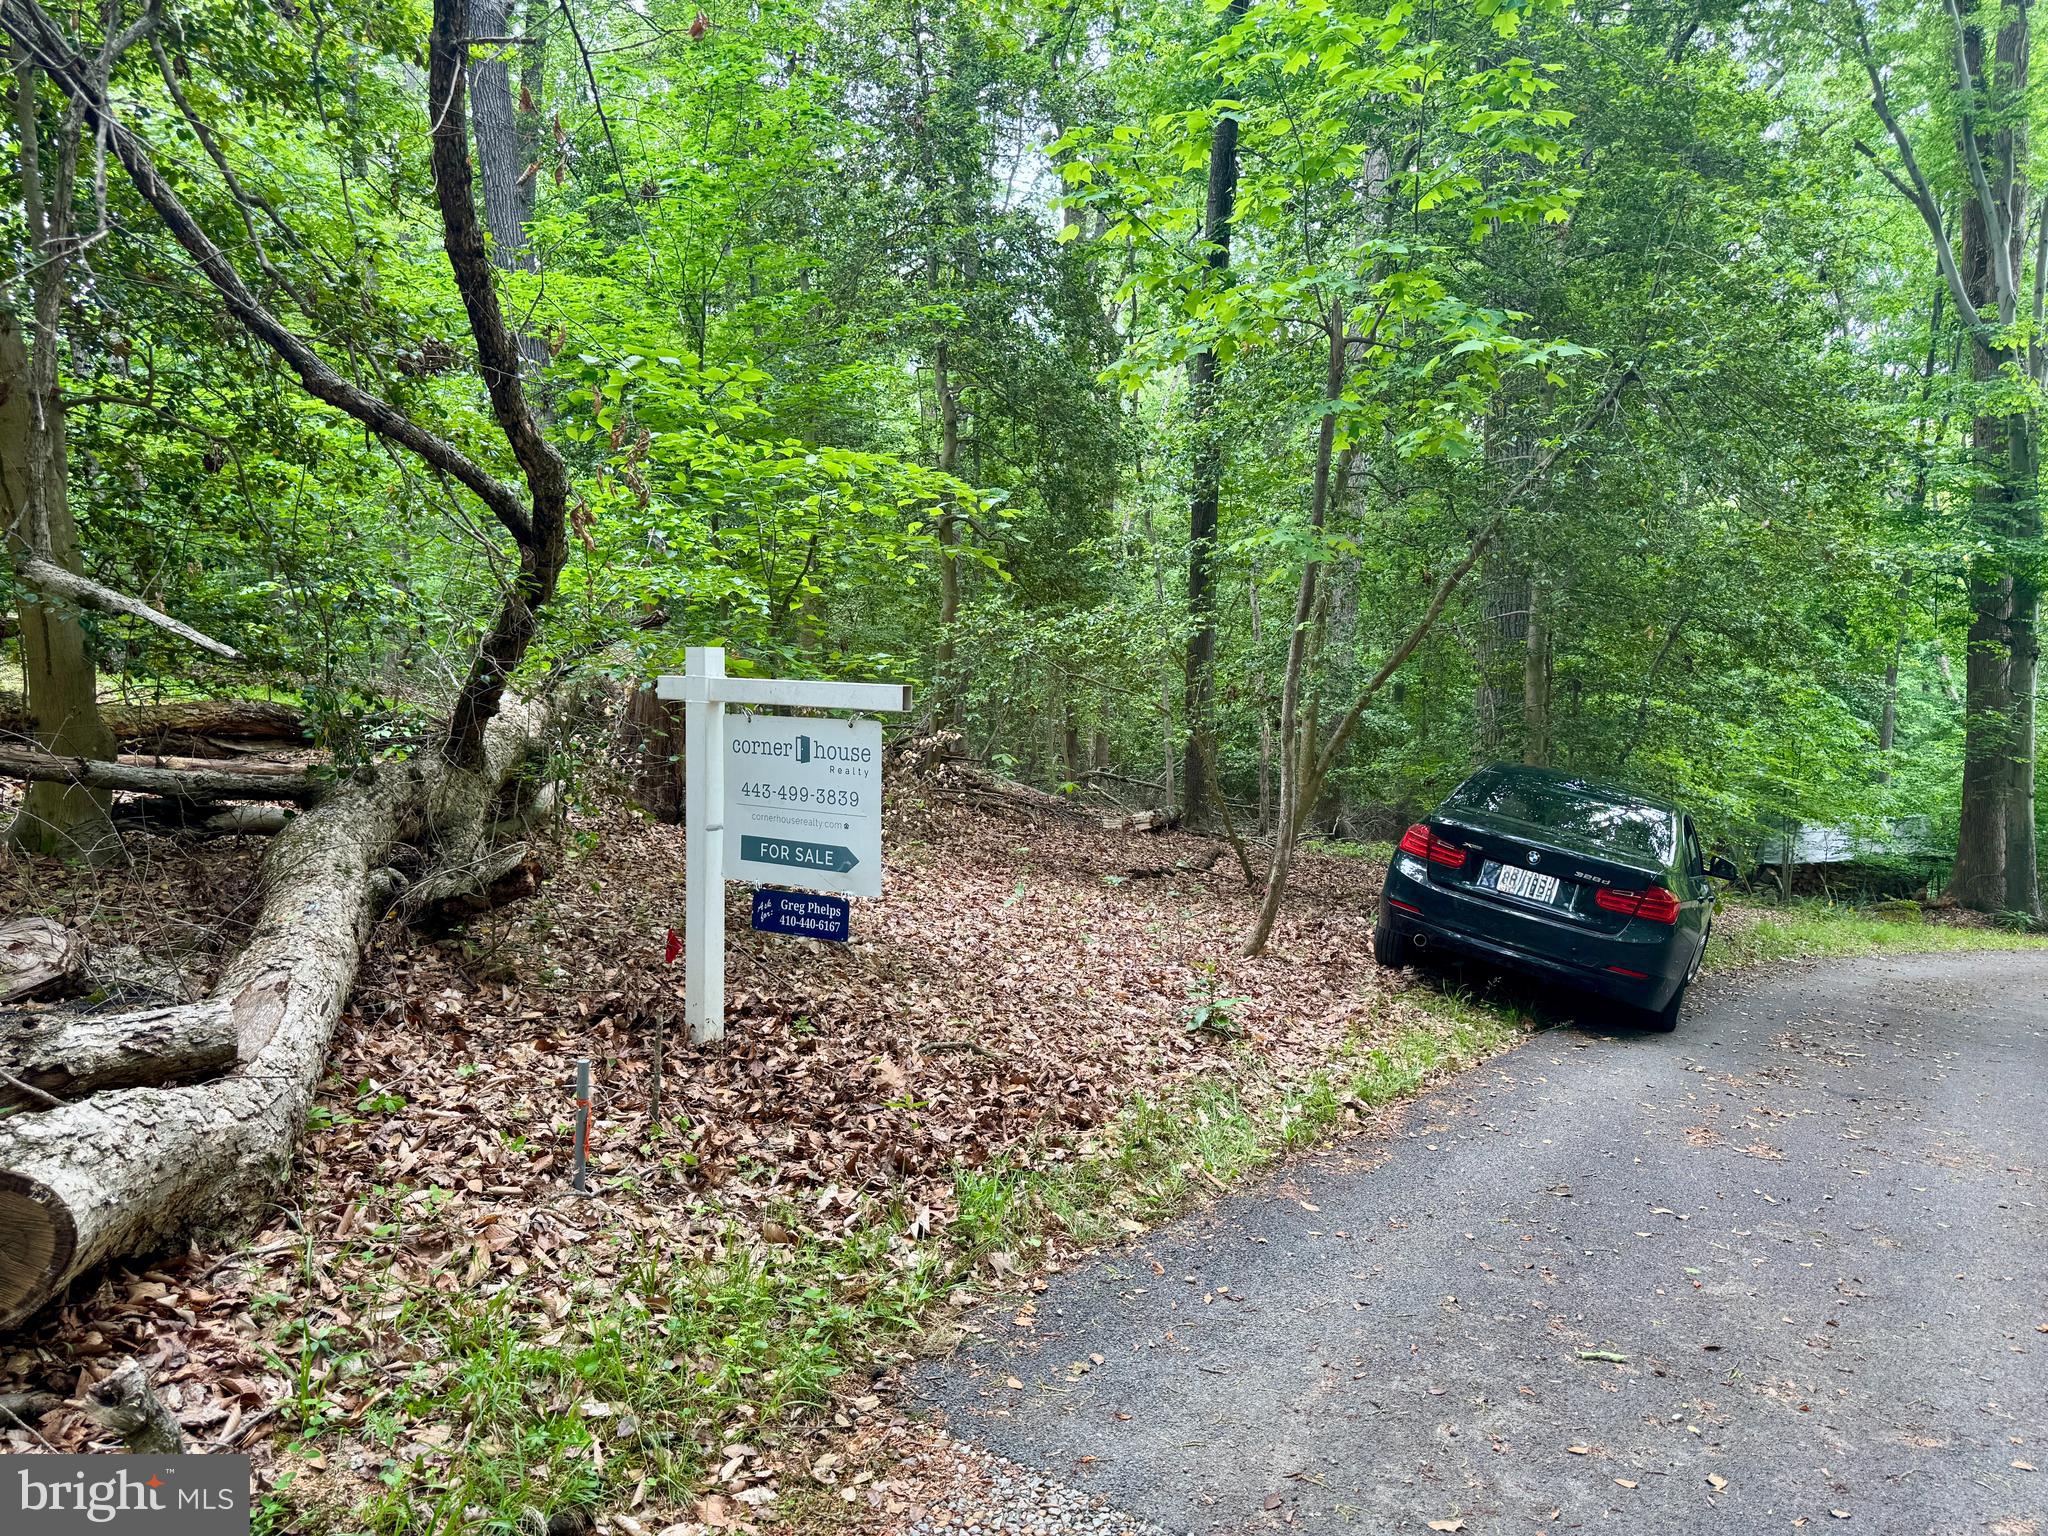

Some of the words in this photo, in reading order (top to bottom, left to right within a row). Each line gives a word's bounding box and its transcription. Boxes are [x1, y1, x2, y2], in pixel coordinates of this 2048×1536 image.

[732, 739, 793, 757] corner
[813, 740, 871, 763] house
[829, 766, 870, 778] Realty
[741, 782, 860, 807] 443-499-3839
[751, 813, 843, 830] cornerhouserealty.com
[760, 843, 790, 861] FOR
[795, 847, 834, 866] SALE
[757, 899, 772, 911] Ask
[780, 899, 805, 915] Greg
[807, 900, 841, 917] Phelps
[760, 910, 774, 923] for:
[779, 914, 841, 933] 410-440-6167
